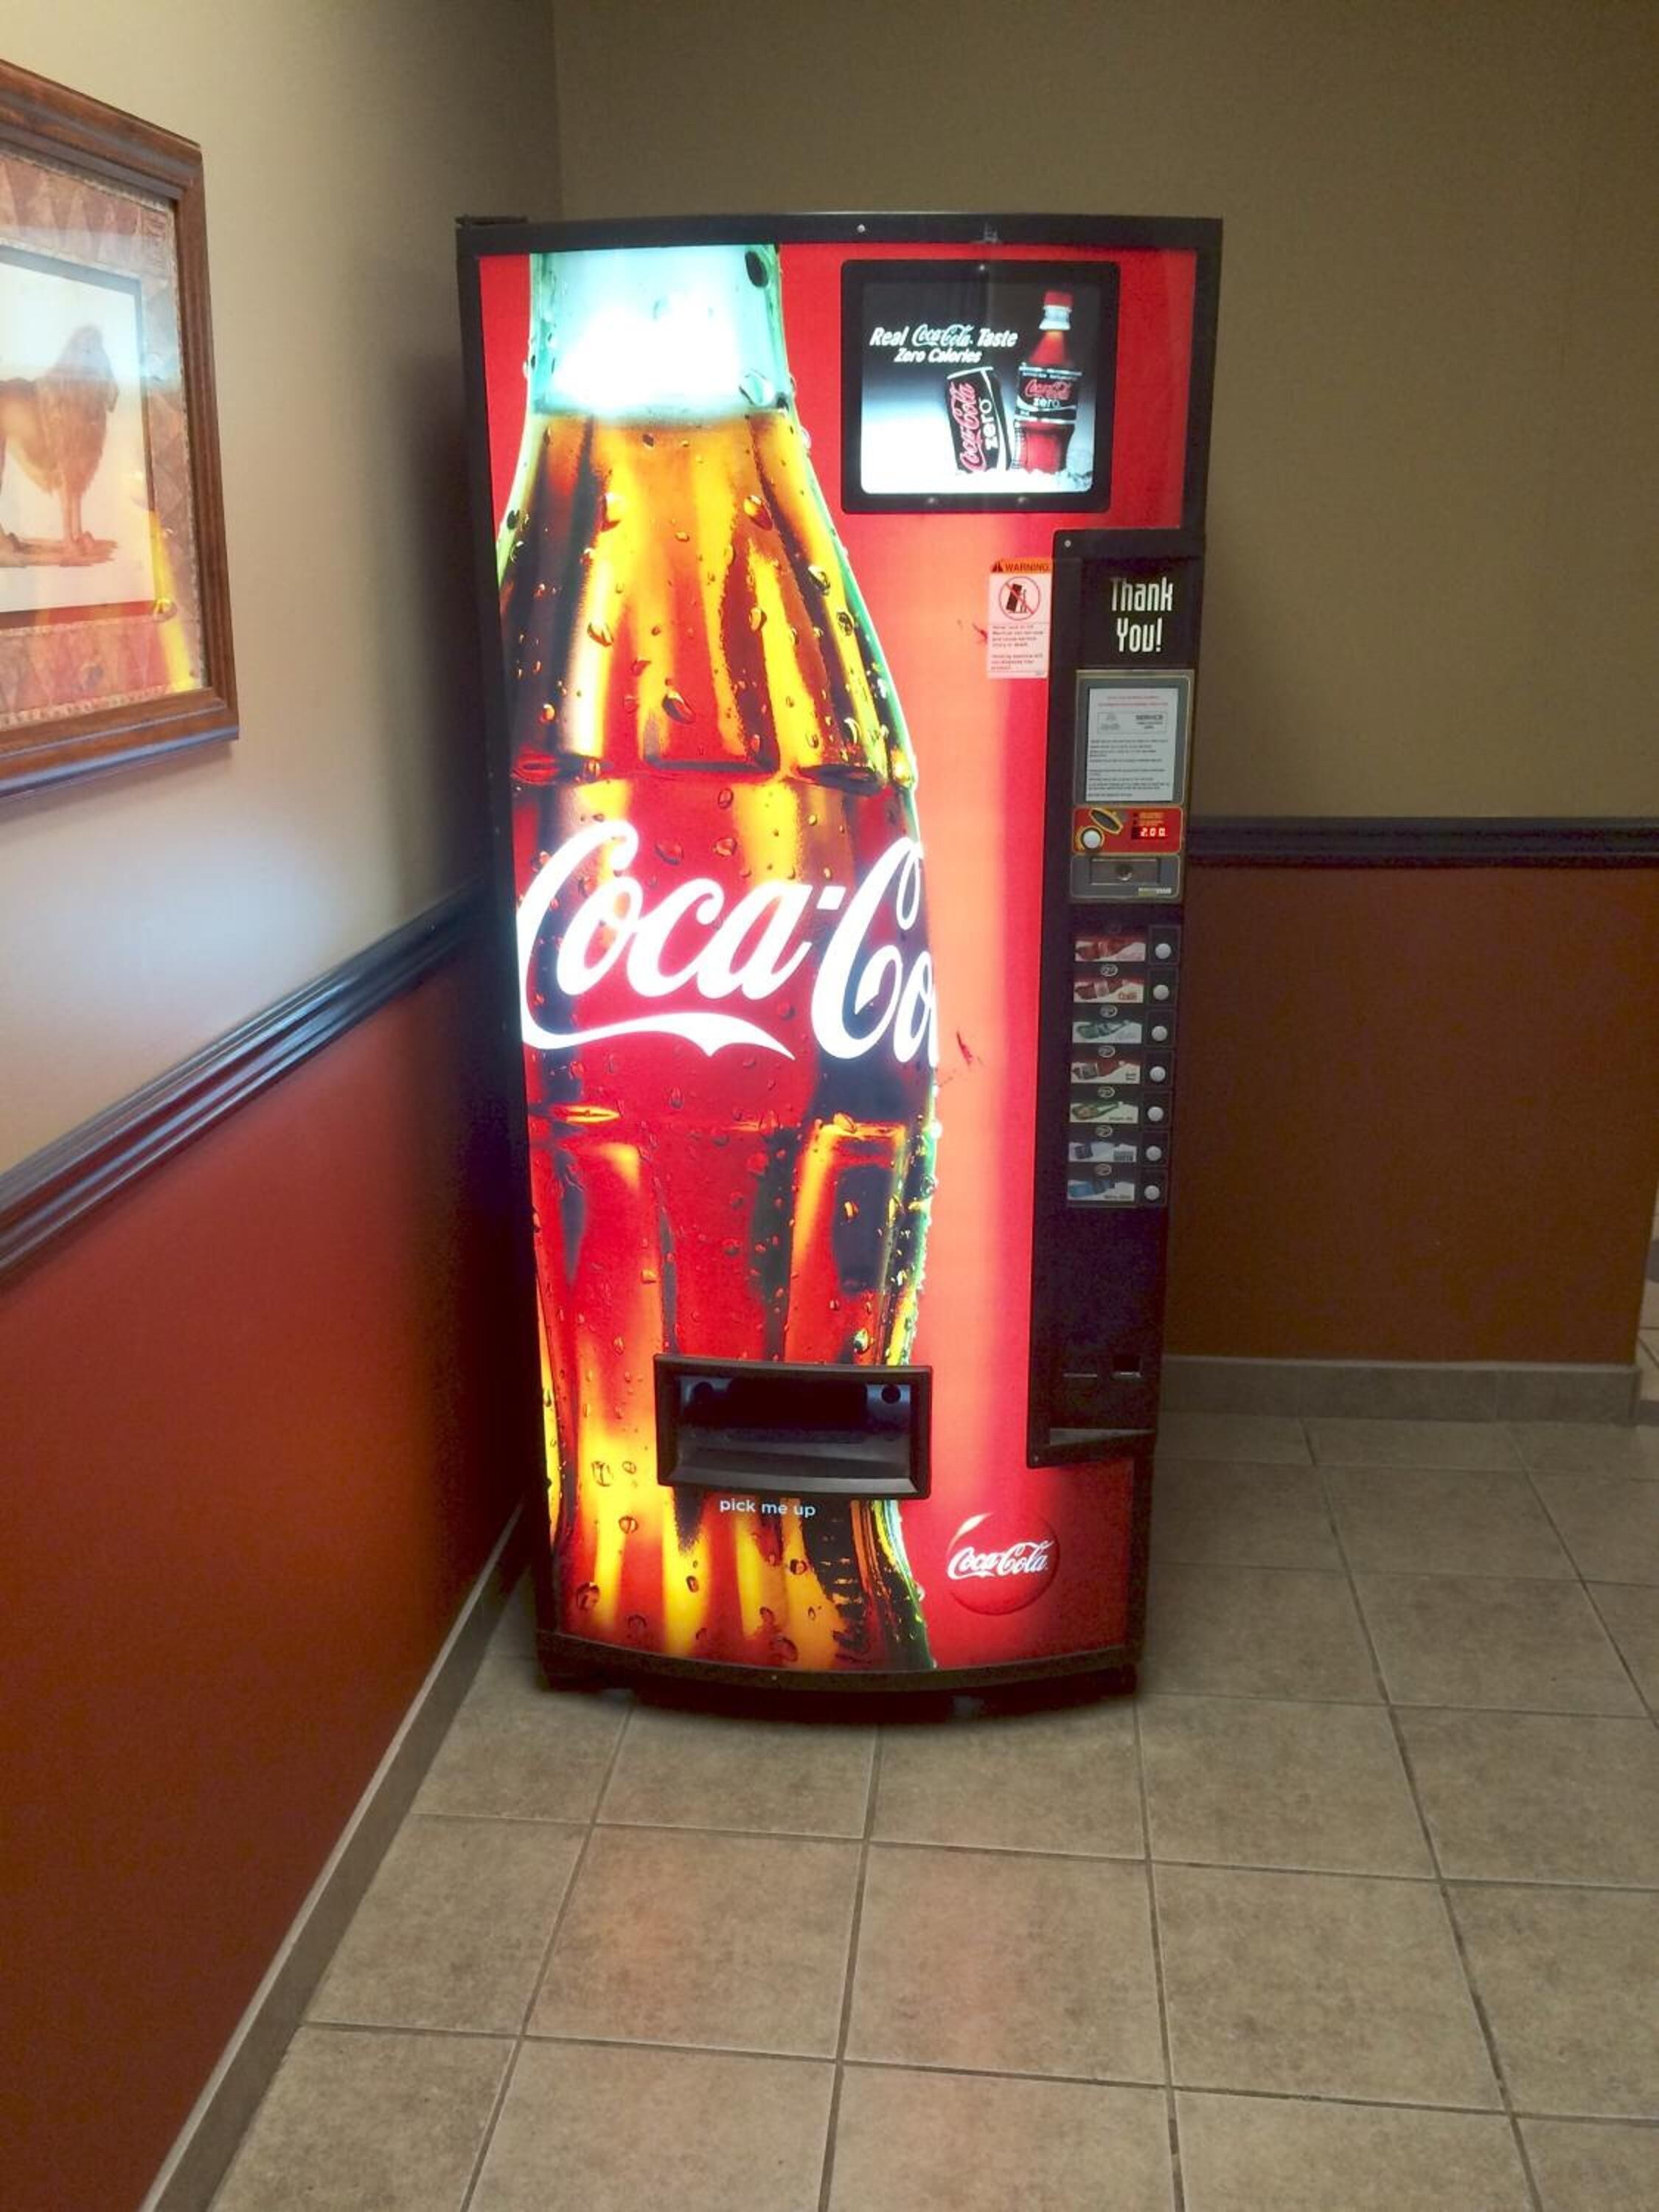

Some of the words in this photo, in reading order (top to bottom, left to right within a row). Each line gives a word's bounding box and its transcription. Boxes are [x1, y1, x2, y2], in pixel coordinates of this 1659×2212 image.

[870, 326, 910, 346] Real
[911, 324, 975, 347] Coca-Cola
[977, 328, 1018, 347] Taste
[894, 348, 925, 363] Zero
[928, 348, 982, 363] Calories
[1005, 563, 1050, 573] WARNING
[1110, 577, 1173, 611] Thank
[1116, 617, 1163, 652] You!
[720, 1498, 756, 1513] pick
[762, 1503, 787, 1514] me
[794, 1505, 815, 1517] up
[947, 1540, 1054, 1580] Coca-Cola
